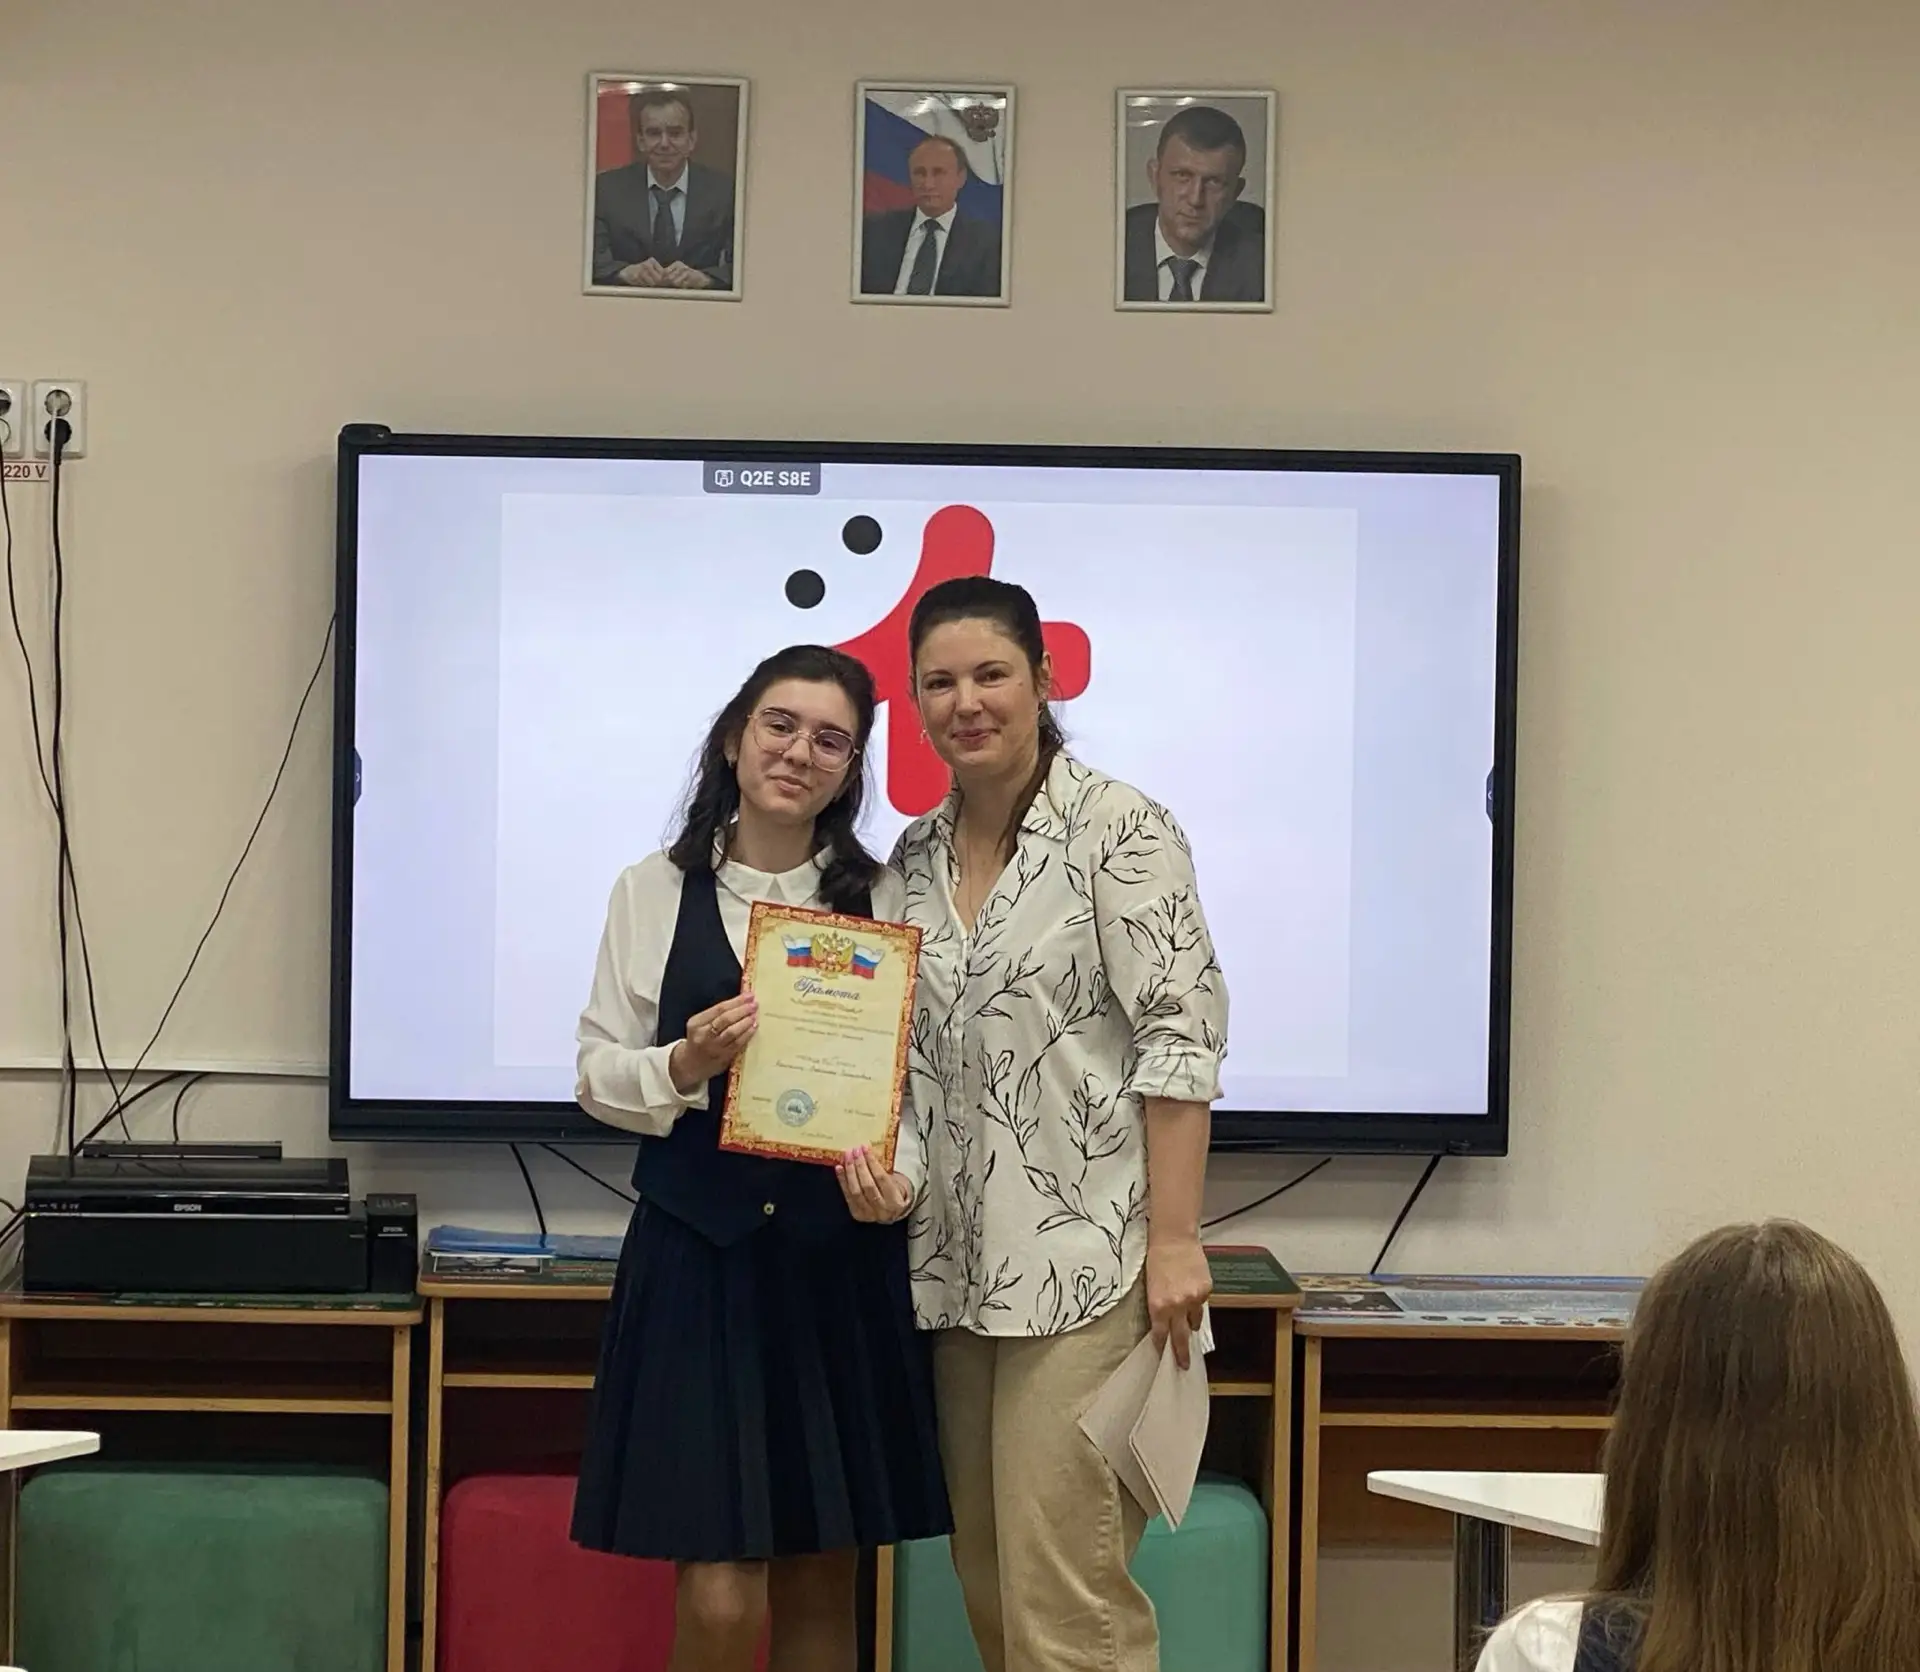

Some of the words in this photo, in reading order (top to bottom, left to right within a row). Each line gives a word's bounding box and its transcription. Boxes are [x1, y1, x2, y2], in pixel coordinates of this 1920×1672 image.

[4, 465, 30, 478] 220
[35, 465, 46, 478] V
[740, 470, 774, 487] Q2E
[778, 471, 811, 486] S8E
[793, 975, 861, 1000] Грамота
[174, 1203, 202, 1212] EPSON
